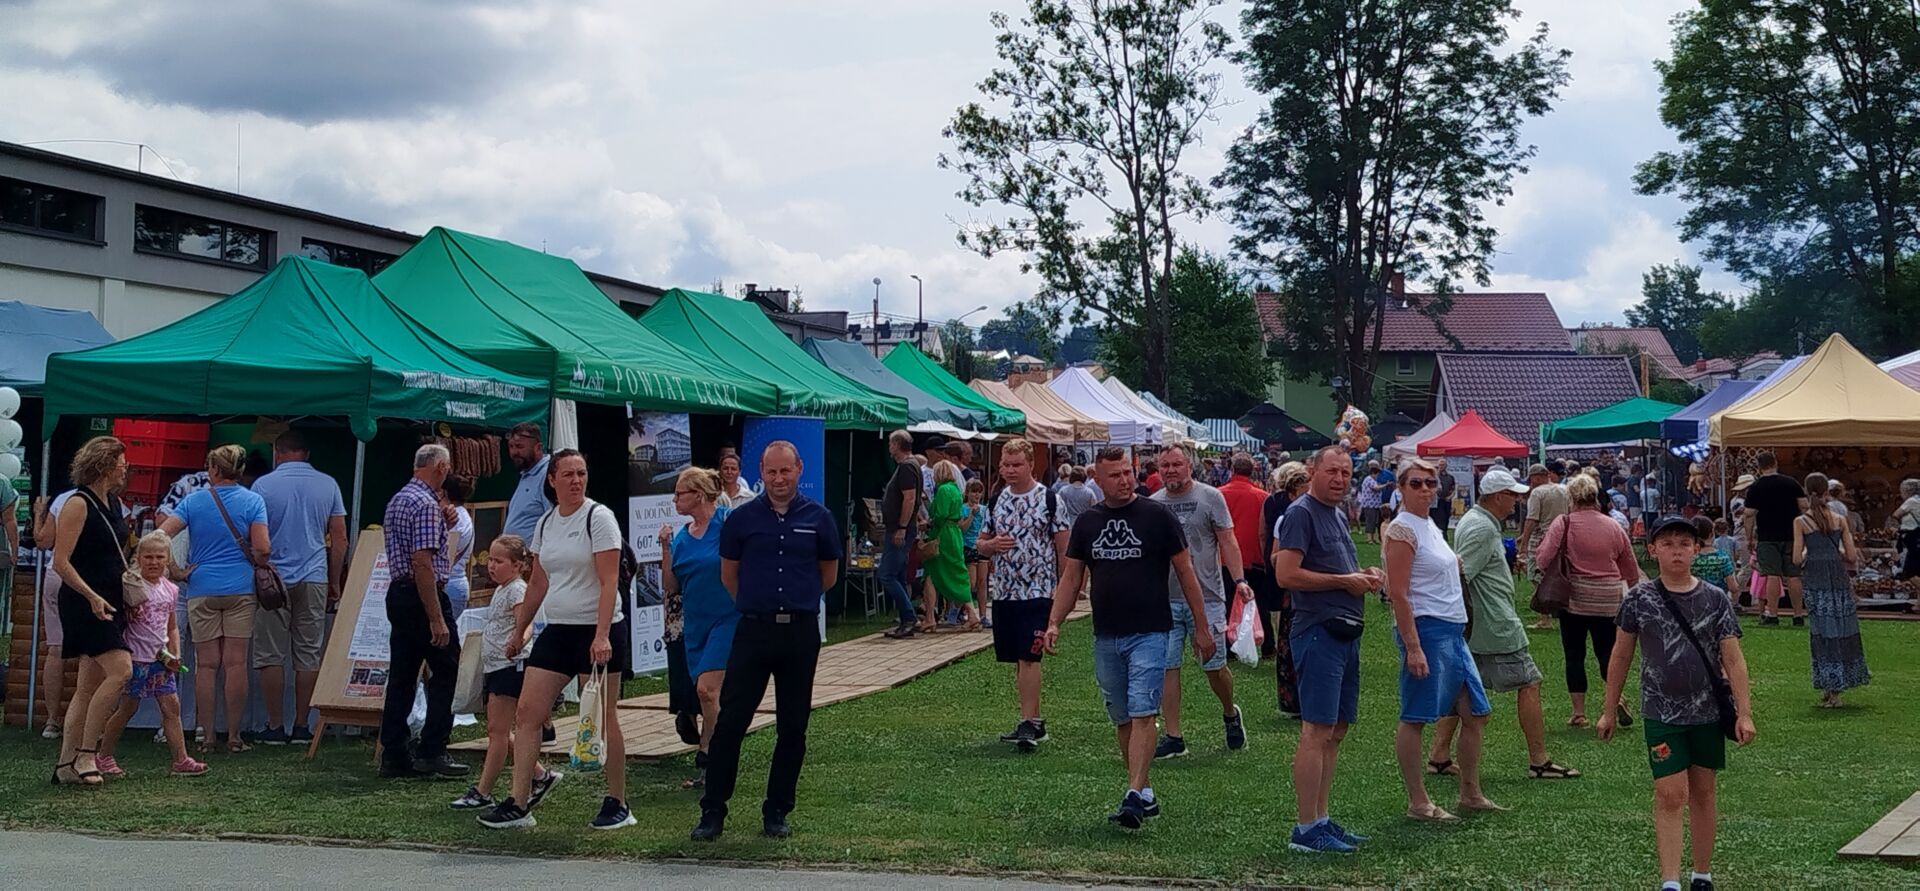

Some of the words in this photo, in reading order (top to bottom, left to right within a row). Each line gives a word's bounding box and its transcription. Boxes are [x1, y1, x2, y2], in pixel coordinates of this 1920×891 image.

[612, 365, 685, 400] POWIAT
[692, 379, 742, 408] LESKI
[637, 535, 653, 549] 607
[1092, 548, 1141, 559] Kappa
